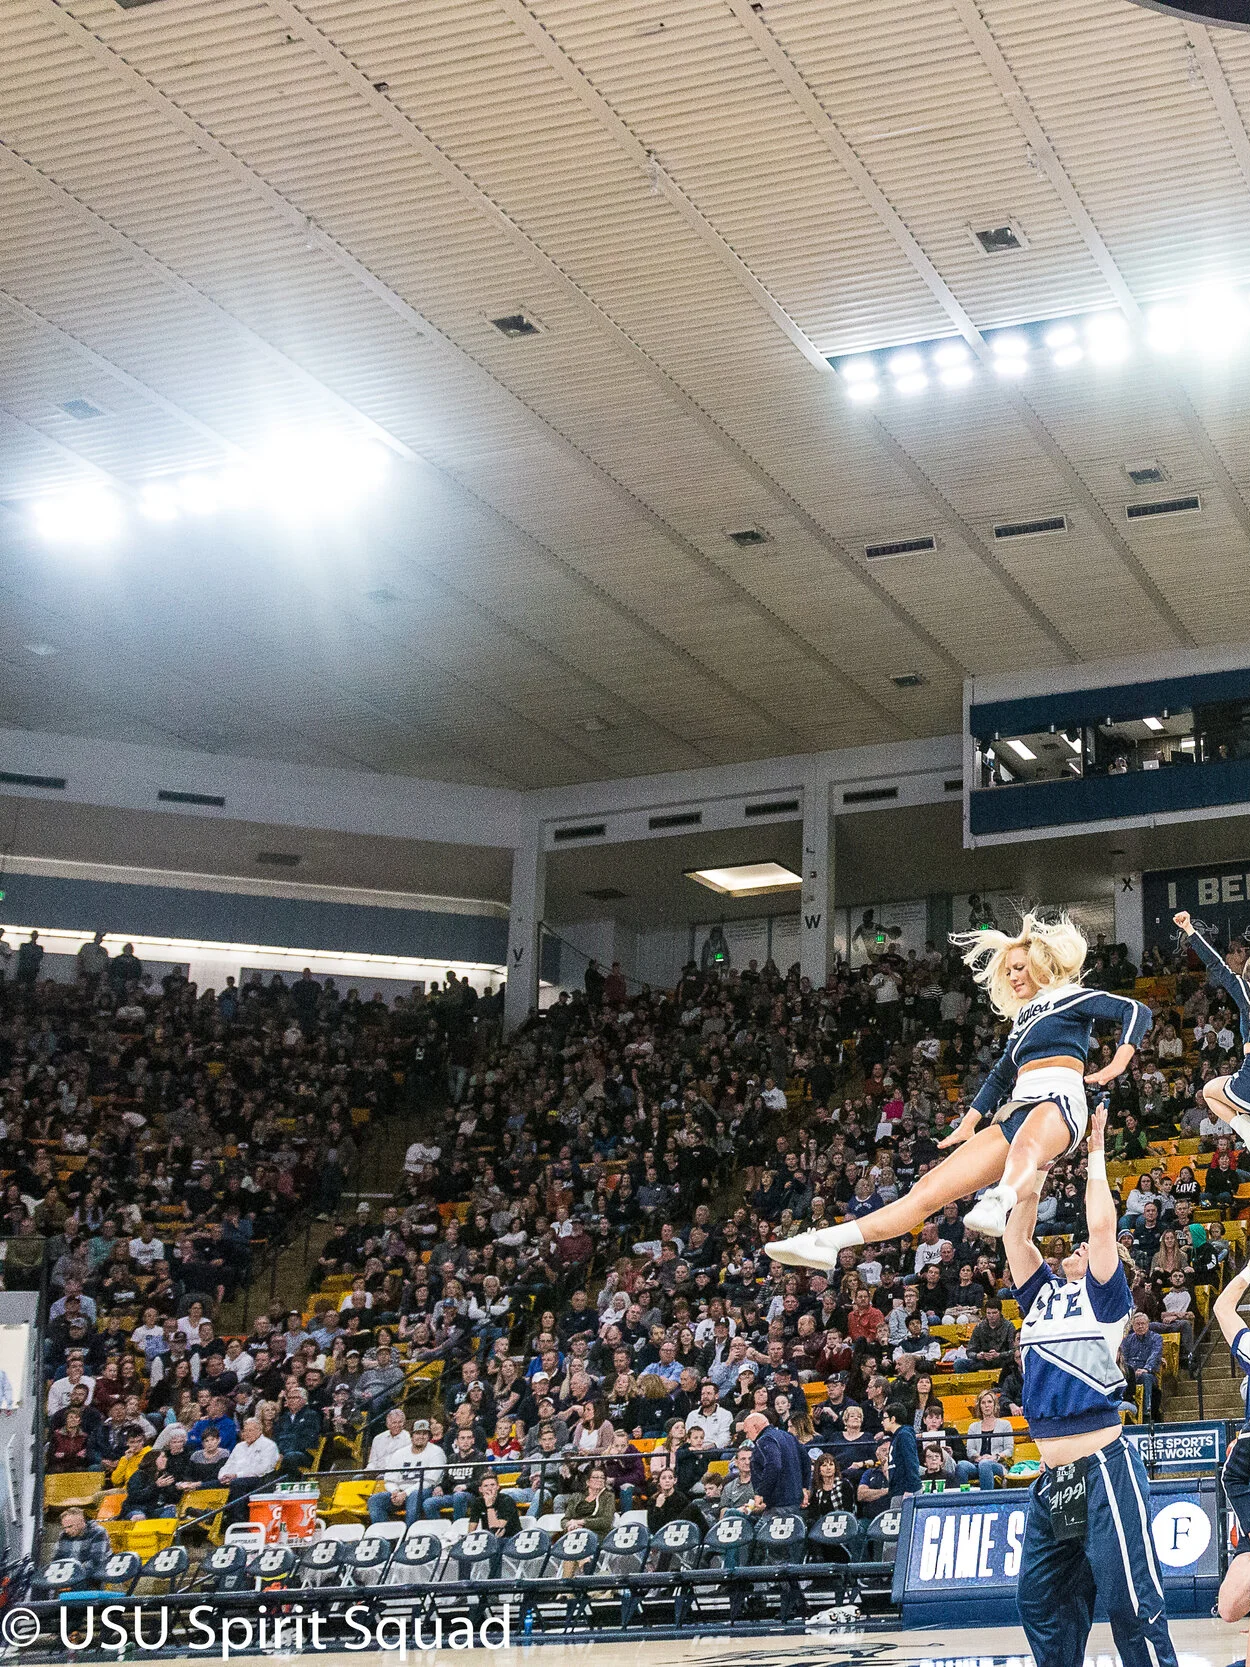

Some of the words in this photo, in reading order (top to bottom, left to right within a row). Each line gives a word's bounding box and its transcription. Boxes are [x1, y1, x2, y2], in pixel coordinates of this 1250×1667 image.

[1121, 877, 1134, 893] X
[1167, 882, 1178, 908] I
[804, 914, 822, 930] W
[512, 948, 523, 960] V
[1165, 1436, 1214, 1448] SPORTS
[1170, 1516, 1192, 1550] F
[919, 1512, 999, 1582] GAME
